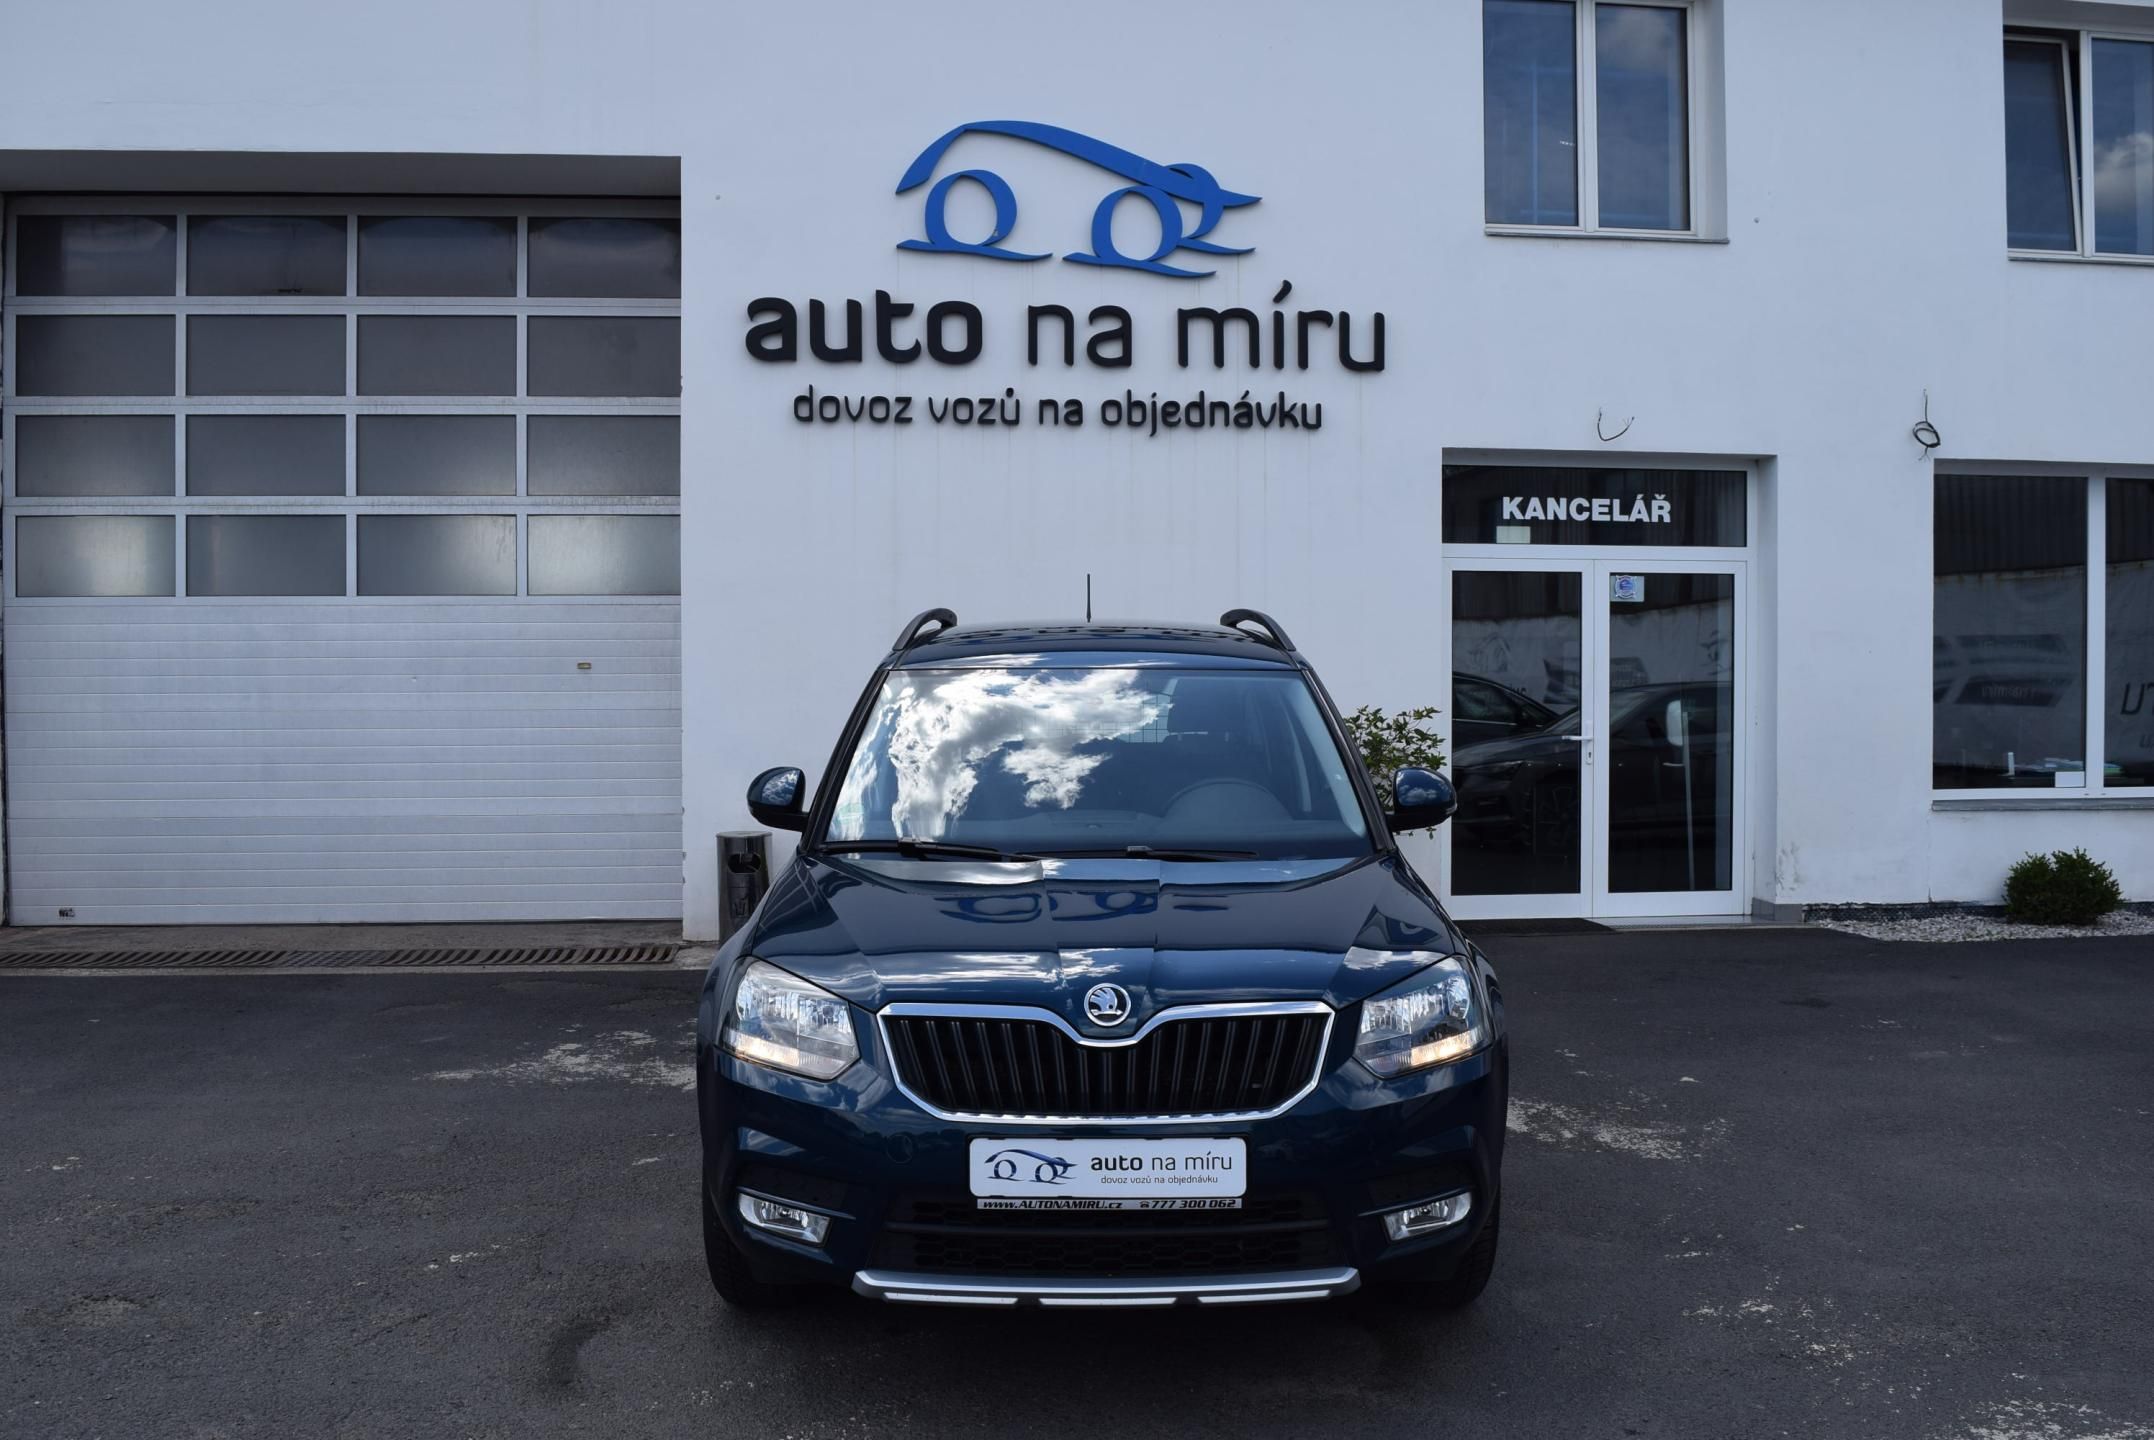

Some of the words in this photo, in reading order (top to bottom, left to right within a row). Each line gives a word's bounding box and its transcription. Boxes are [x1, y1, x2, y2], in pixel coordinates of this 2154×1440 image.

[745, 289, 983, 363] auto
[1028, 304, 1133, 367] na
[1177, 280, 1385, 372] míru
[794, 385, 912, 423] dovoz
[928, 387, 1020, 426] vozů
[1039, 395, 1083, 426] na
[1101, 389, 1321, 437] objednávku
[1502, 494, 1671, 522] KANCELÁŘ
[1090, 1153, 1143, 1171] auto
[1152, 1155, 1176, 1171] na
[1185, 1150, 1232, 1171] míru
[1101, 1175, 1127, 1185] dovoz
[1154, 1177, 1165, 1185] na
[1168, 1174, 1218, 1186] objednávku
[1179, 1199, 1207, 1209] 300
[1209, 1198, 1236, 1209] 062
